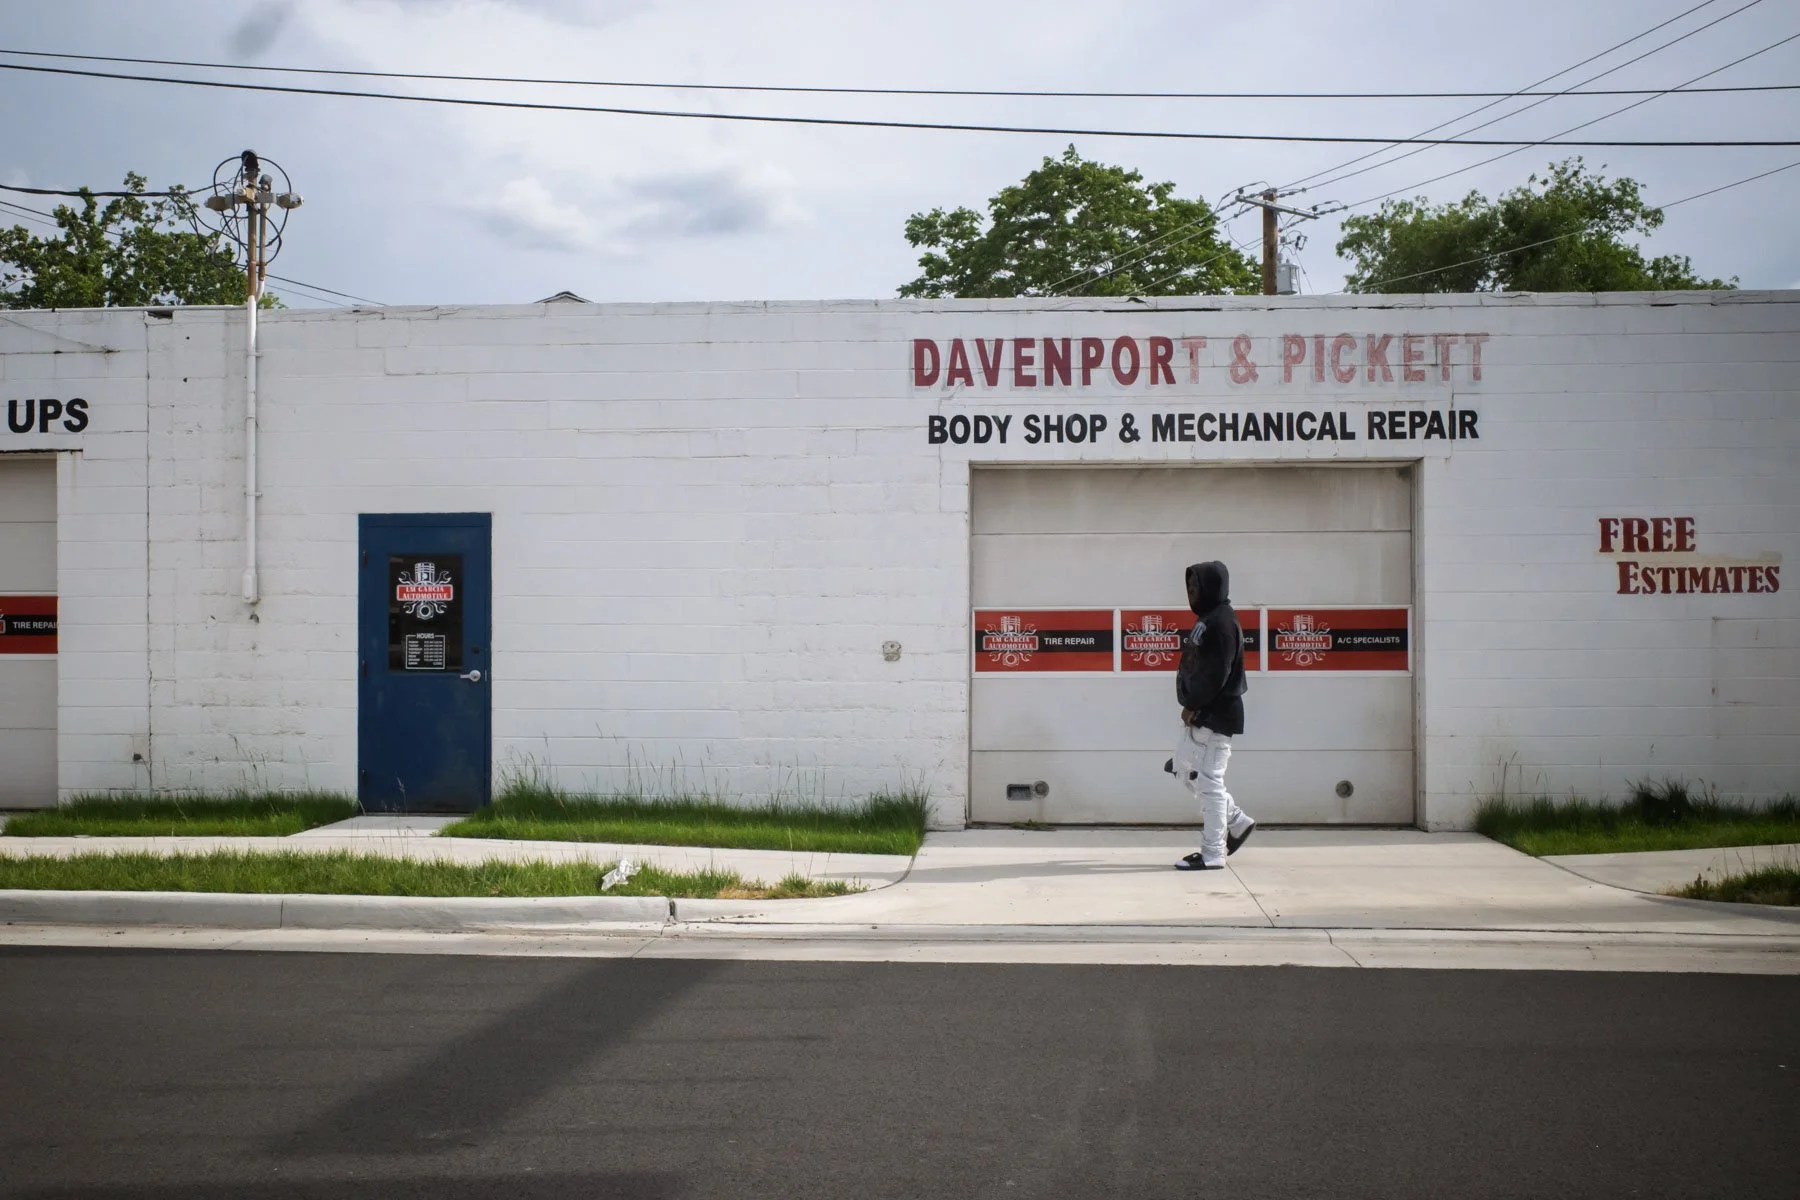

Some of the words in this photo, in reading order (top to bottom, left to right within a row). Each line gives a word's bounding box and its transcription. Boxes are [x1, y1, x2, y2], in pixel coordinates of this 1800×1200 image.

[913, 335, 1207, 388] DAVENPORT
[1229, 334, 1260, 385] &
[1282, 332, 1489, 384] PICKETT
[8, 398, 89, 434] UPS
[928, 413, 1013, 445] BODY
[1022, 412, 1108, 444] SHOP
[1118, 412, 1142, 444] &
[1151, 410, 1357, 443] MECHANICAL
[1367, 409, 1480, 441] REPAIR
[1598, 516, 1696, 553] FREE
[12, 621, 31, 629] TIRE
[32, 621, 57, 629] REPAI
[1043, 637, 1063, 645] TIRE
[1064, 637, 1095, 645] REPAIR
[1337, 637, 1352, 645] A/C
[1353, 636, 1400, 644] SPECIALISTS
